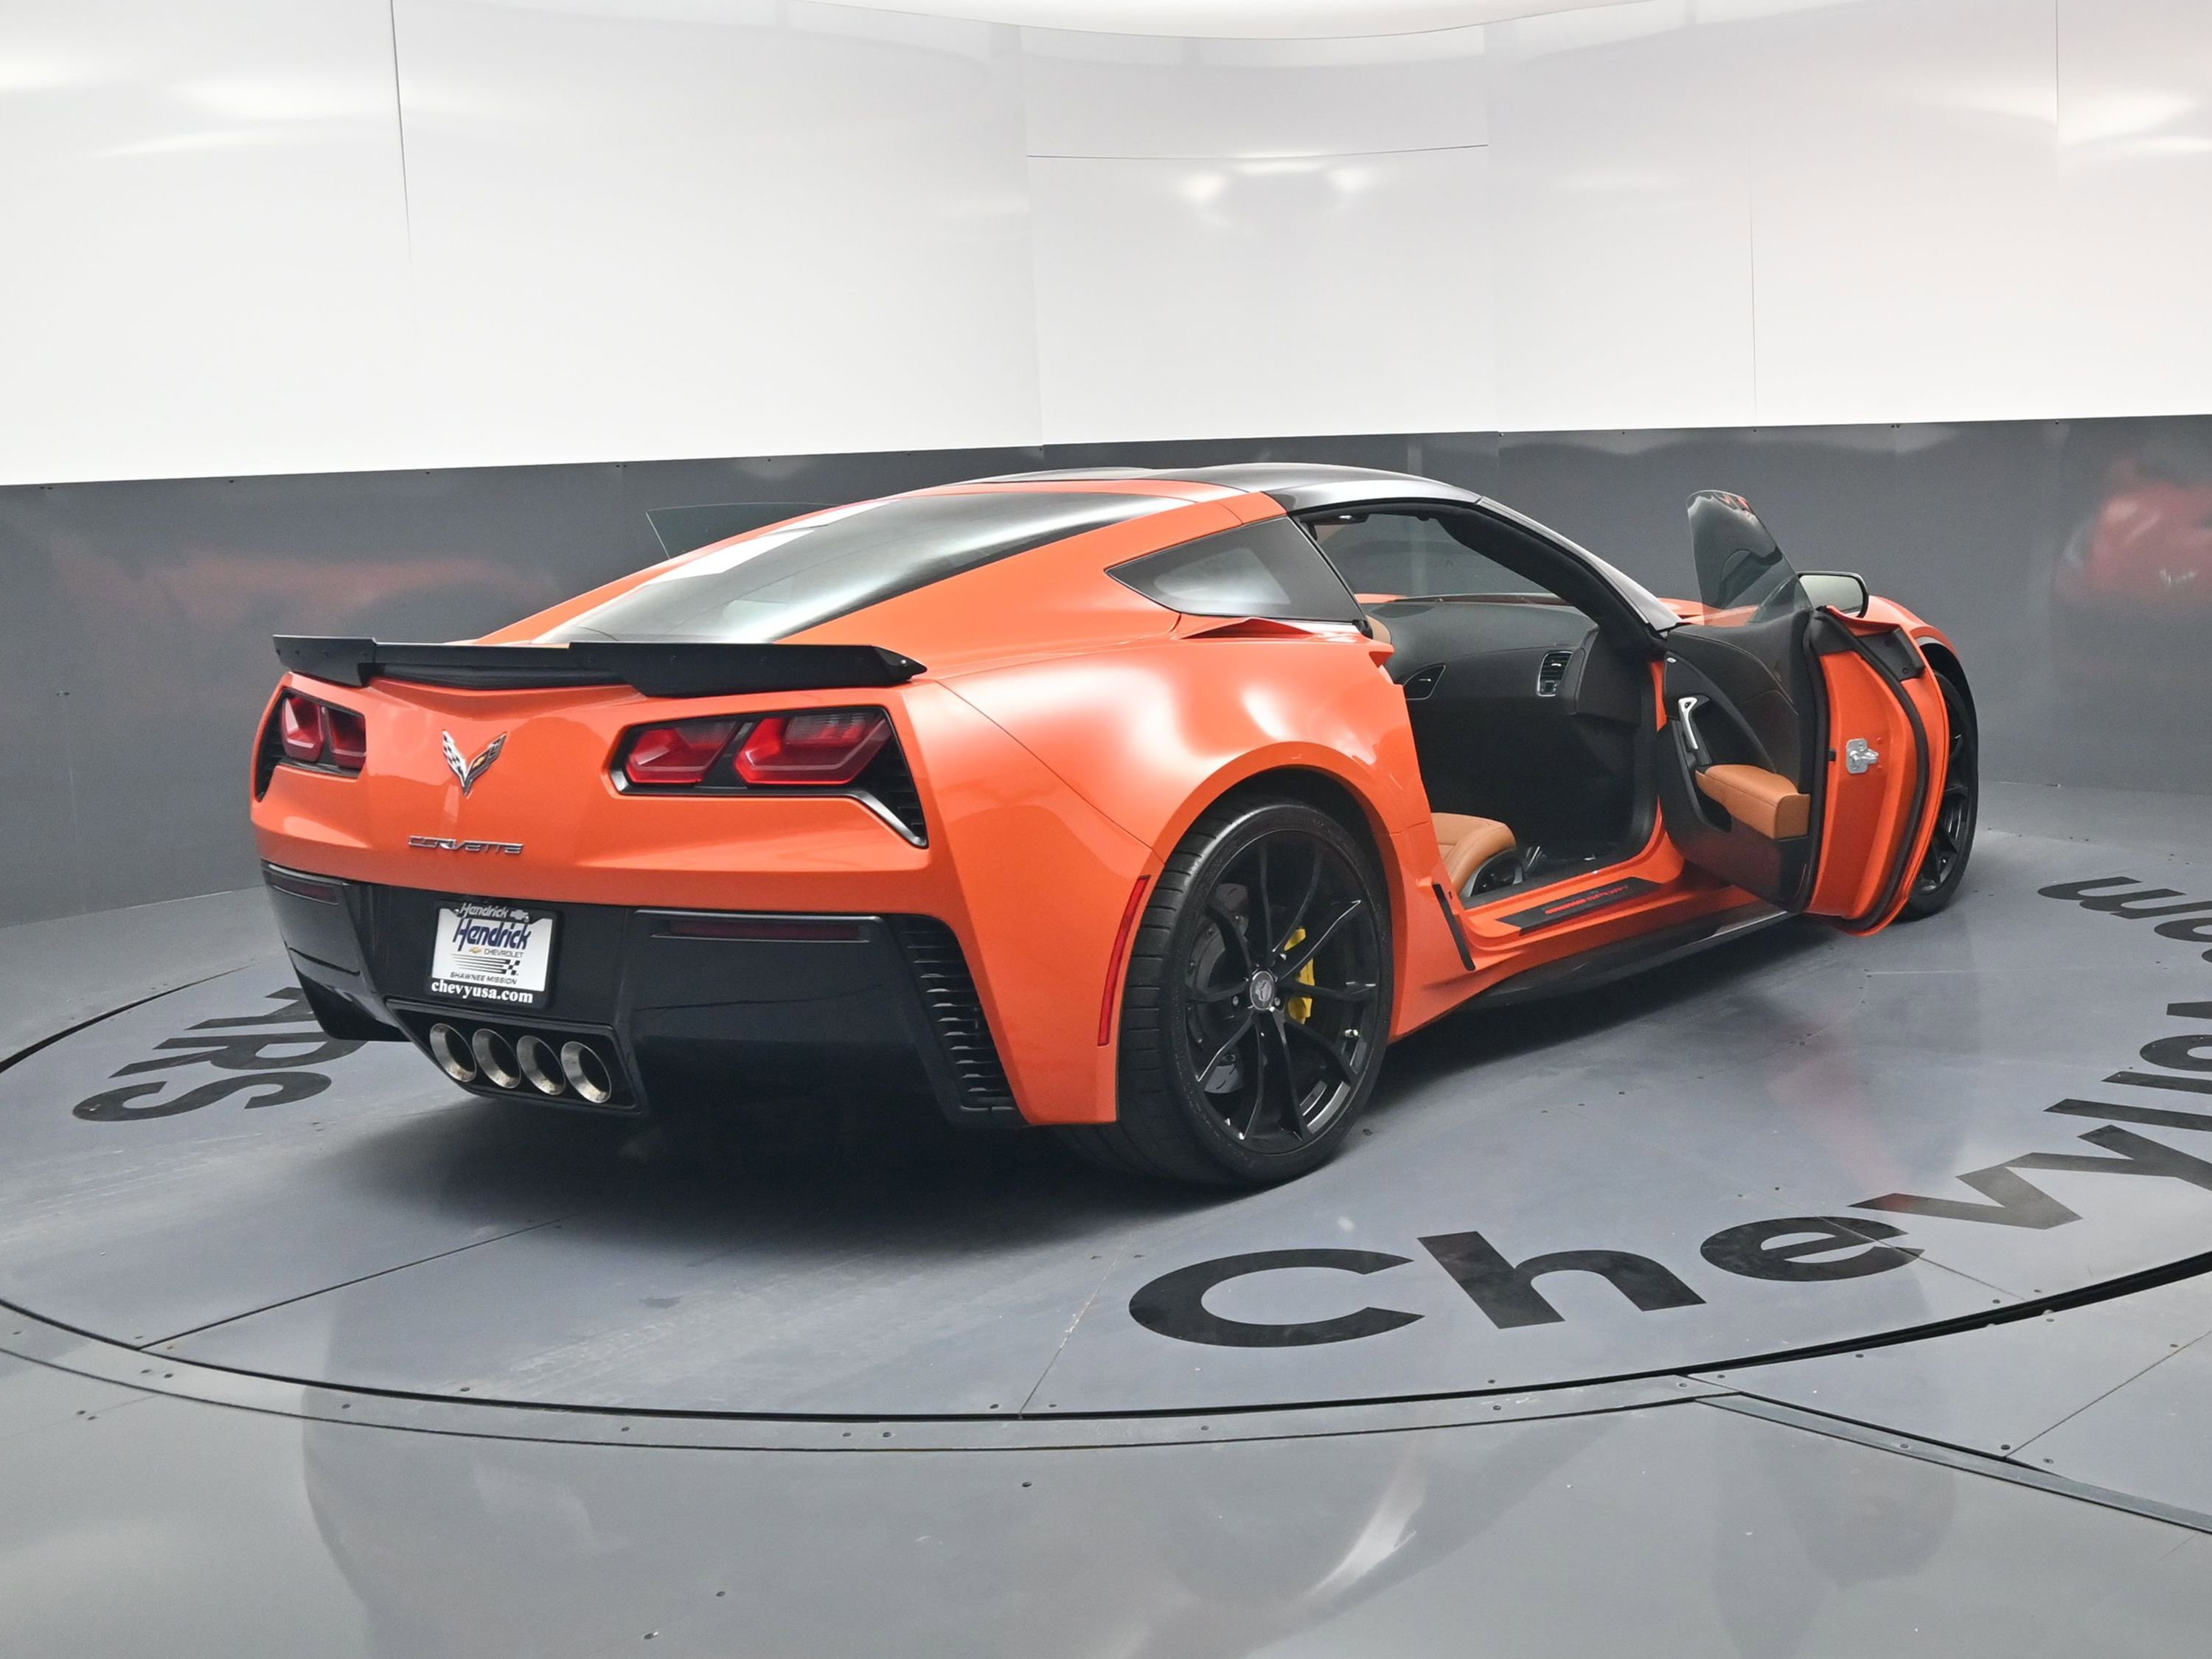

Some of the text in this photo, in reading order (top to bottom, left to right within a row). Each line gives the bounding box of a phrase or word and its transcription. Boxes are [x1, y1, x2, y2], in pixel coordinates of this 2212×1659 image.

[408, 835, 524, 853] CORVETTE
[459, 902, 509, 919] Hendrick
[452, 918, 532, 951] Hendrick
[484, 948, 524, 959] CHEVROLET
[450, 971, 518, 985] SHAWNEE MISSION
[431, 980, 533, 1004] chevyusa.com
